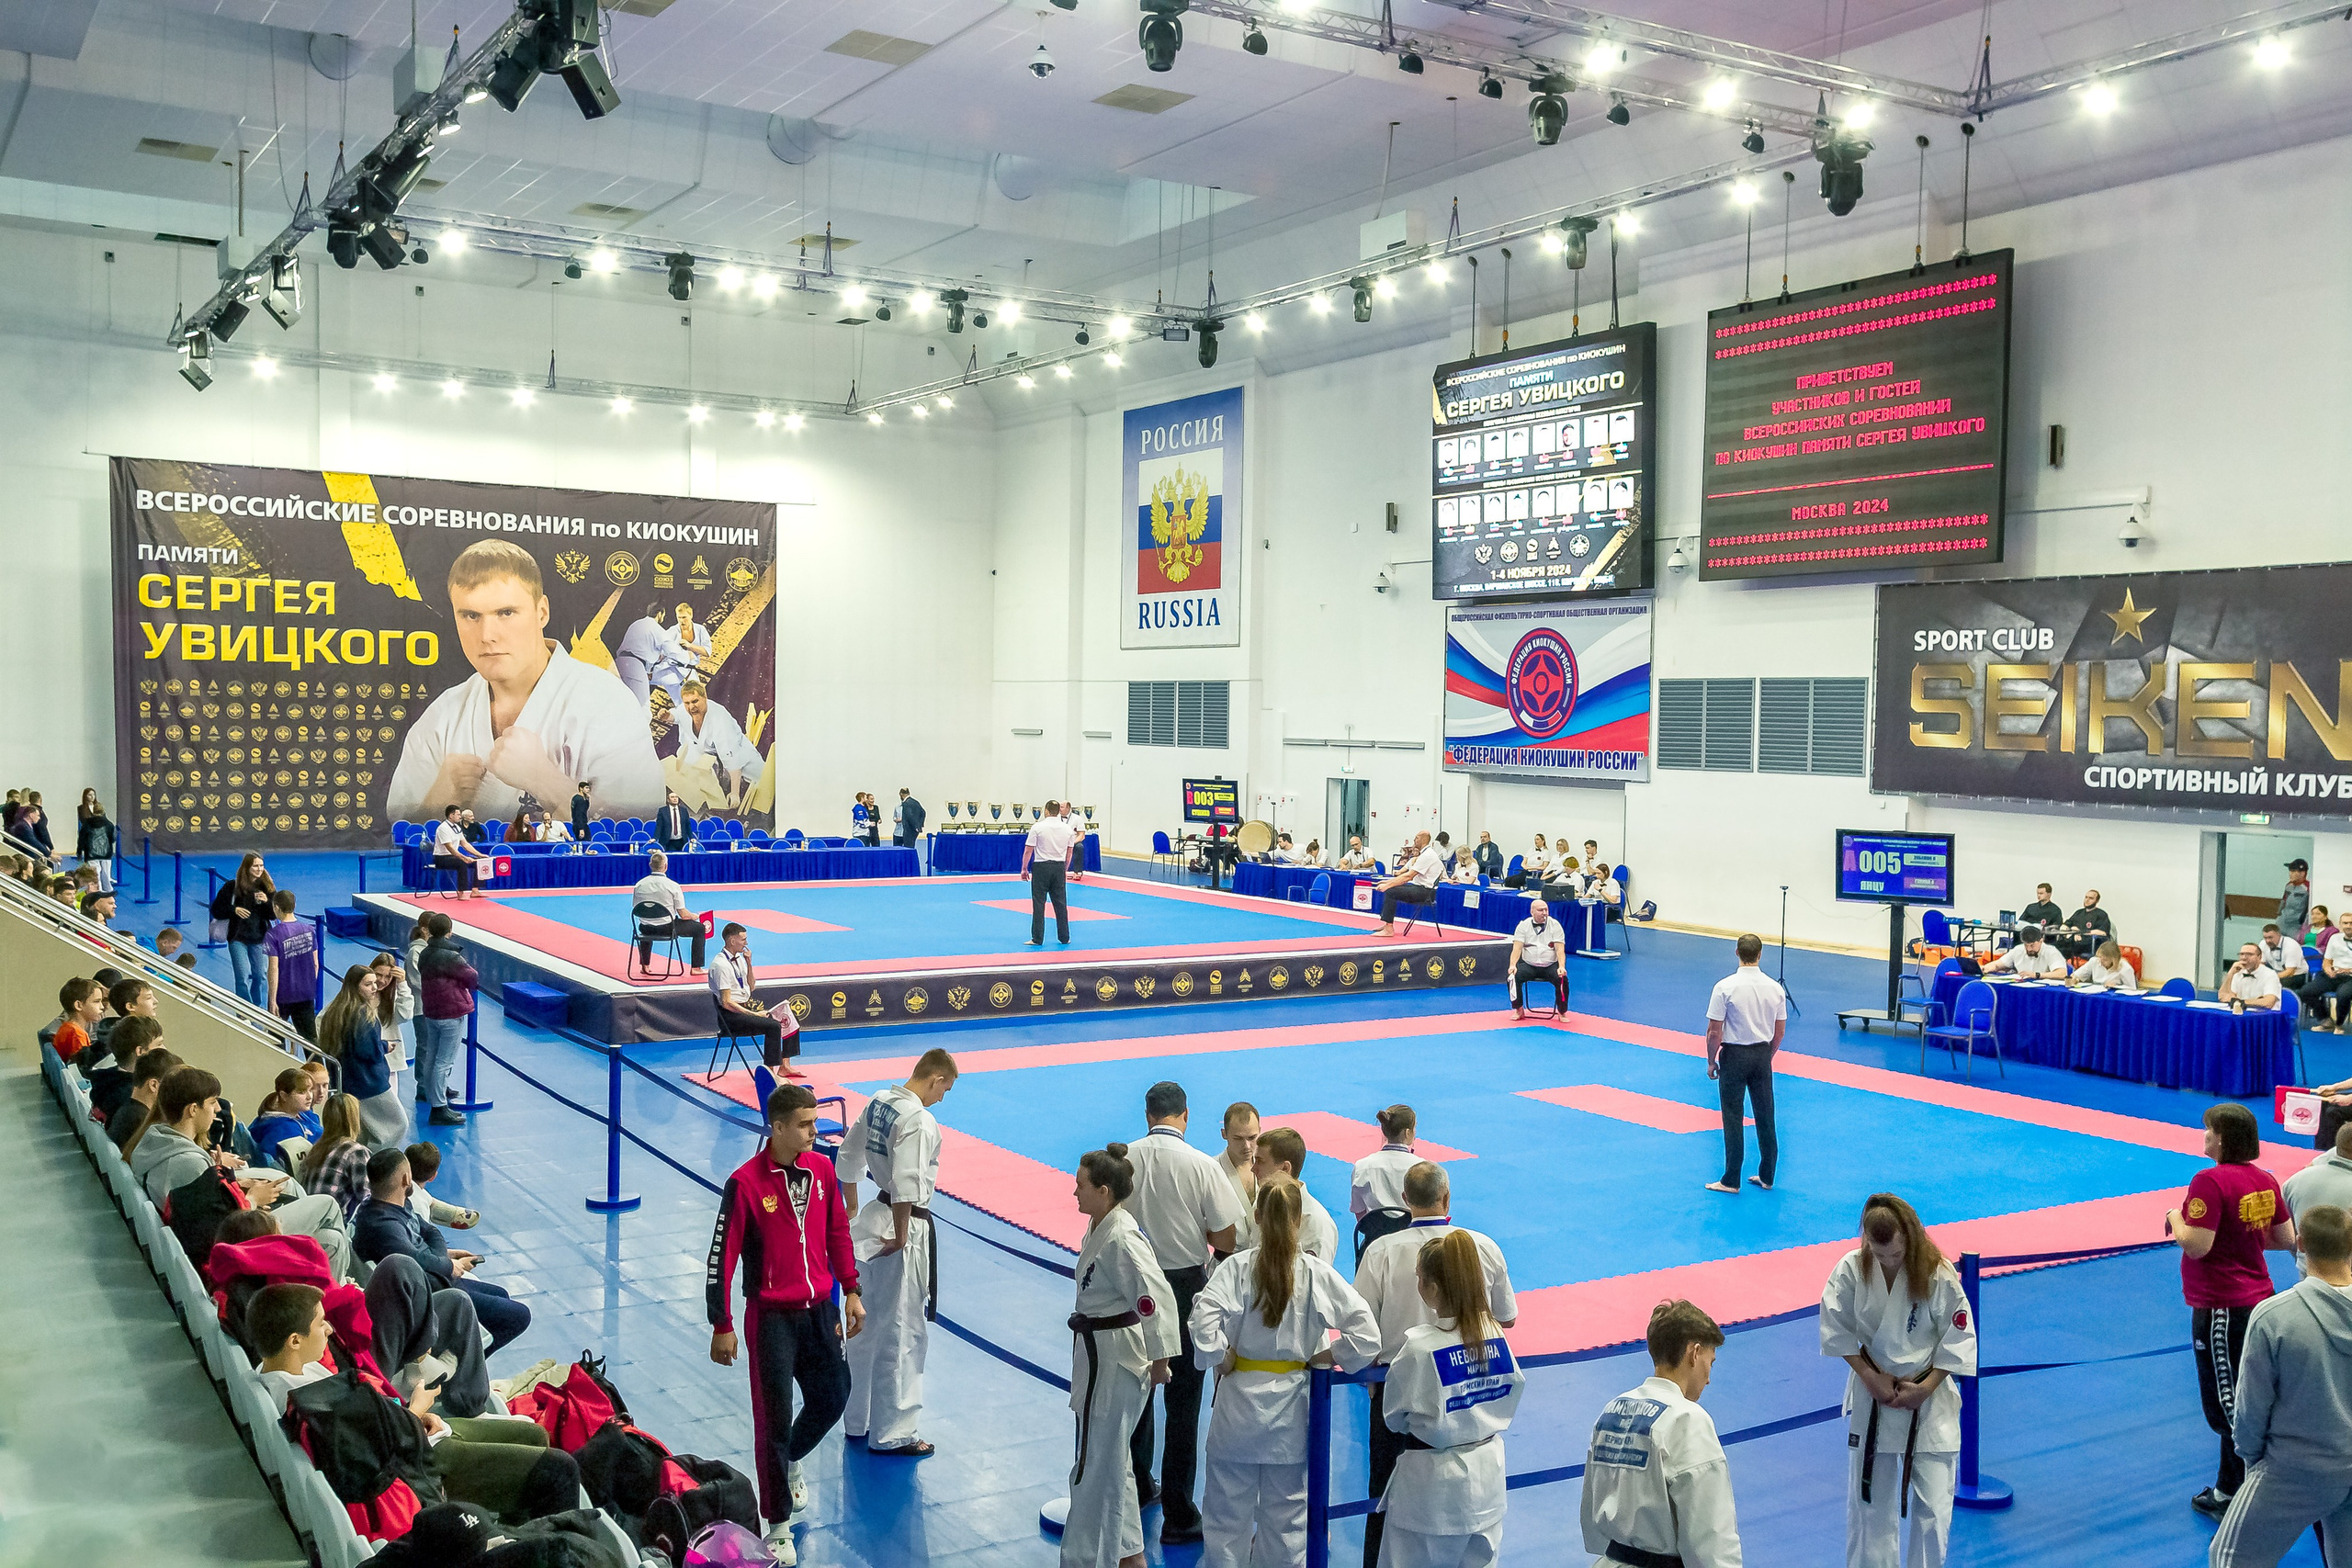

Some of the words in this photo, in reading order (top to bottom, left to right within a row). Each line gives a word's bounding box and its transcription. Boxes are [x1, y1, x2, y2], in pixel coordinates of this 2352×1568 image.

[1578, 344, 1626, 362] КИОКУШИН
[1509, 370, 1554, 389] ПАМЯТИ
[1796, 361, 1894, 390] ПРИВЕТСТВУЕМ
[1446, 391, 1513, 418] СЕРГЕЯ
[1519, 370, 1625, 406] УВИЦКОГО
[1771, 390, 1850, 415] УЧАСТНИКОВ
[1854, 389, 1865, 403] И
[1869, 378, 1921, 401] ГОСТЕЙ
[1744, 414, 1846, 441] ВСЕРОССИЙСКИХ
[1849, 398, 1951, 426] СОРЕВНОВАНИЙ
[1140, 414, 1224, 455] РОССИЯ
[1714, 452, 1730, 466] ПО
[1734, 443, 1798, 464] КИОКУШИН
[1802, 435, 1852, 456] ПАМЯТИ
[1856, 428, 1907, 448] СЕРГЕЯ
[1911, 417, 1986, 442] УВИЦКОГО
[135, 489, 377, 525] ВСЕРОССИЙСКИЕ
[381, 504, 586, 536] СОРЕВНОВАНИЯ
[590, 523, 620, 538] по
[627, 521, 760, 547] КИОКУШИН
[1792, 502, 1847, 522] МОСКВА
[1852, 498, 1890, 515] 2024
[137, 543, 240, 566] ПАМЯТИ
[1507, 566, 1545, 580] НОЯБРЯ
[1546, 564, 1572, 577] 2024
[138, 572, 336, 616] СЕРГЕЯ
[1137, 597, 1221, 630] RUSSIA
[1566, 607, 1608, 618] ОБЩЕСТВЕННАЯ
[1608, 605, 1647, 616] ОРГАНИЗАЦИЯ
[139, 621, 440, 671] УВИЦКОГО
[1913, 628, 1987, 652] SPORT
[1992, 627, 2054, 651] CLUB
[1510, 642, 1533, 685] ФЕДЕРАЦИЯ
[1532, 637, 1563, 656] КИОКУШИН
[1559, 652, 1573, 684] РОССИИ
[1908, 658, 2352, 761] SEIKEN
[1520, 748, 1586, 769] КИОКУШИН
[2084, 765, 2268, 796] СПОРТИВНЫЙ
[2276, 773, 2352, 799] КЛУБ
[1193, 791, 1215, 807] 003
[1859, 850, 1902, 874] 005
[1467, 1363, 1489, 1375] МАРИЯ
[458, 1512, 480, 1529] LA
